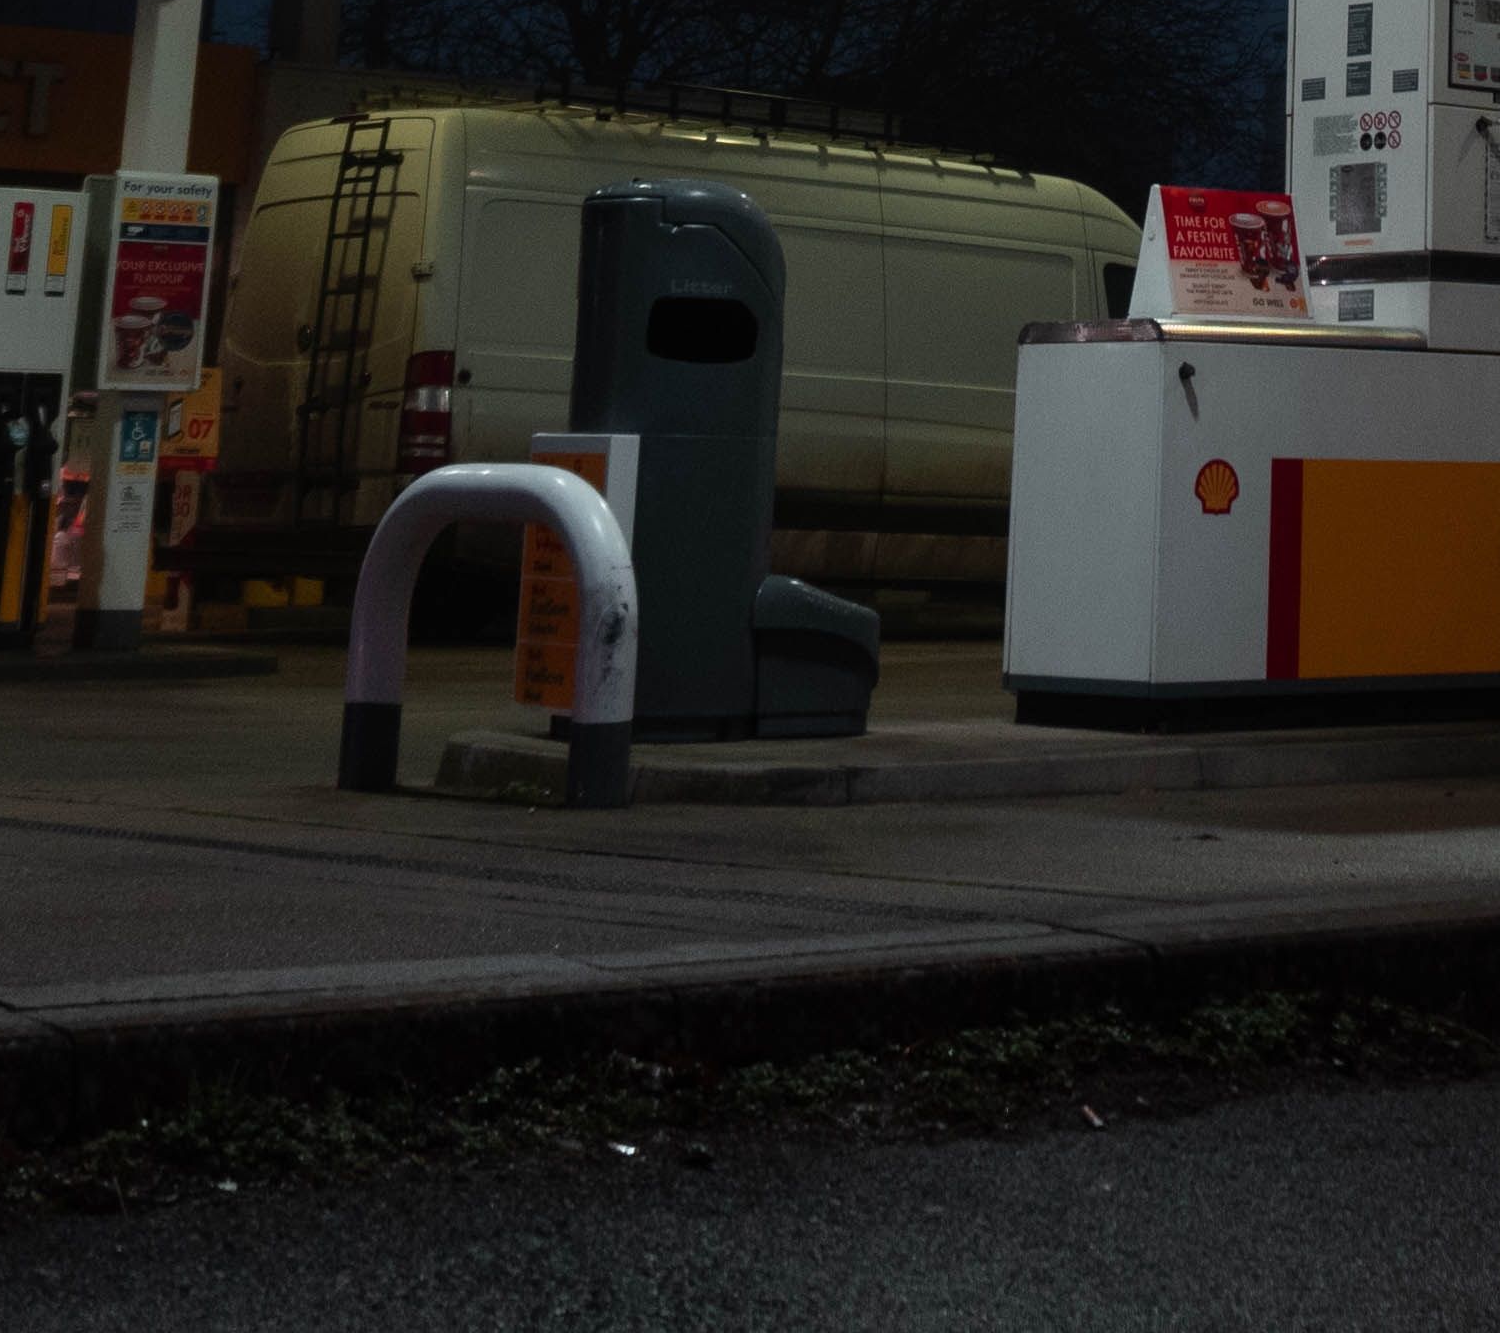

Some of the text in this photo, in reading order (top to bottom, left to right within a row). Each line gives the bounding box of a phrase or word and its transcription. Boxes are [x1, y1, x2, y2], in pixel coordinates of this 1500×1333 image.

[124, 180, 212, 197] For your safety
[1173, 215, 1226, 229] TIME FOR
[1175, 231, 1229, 246] A FESTIVE
[1173, 245, 1236, 261] FAVOURITE
[1253, 297, 1284, 309] GO WELL
